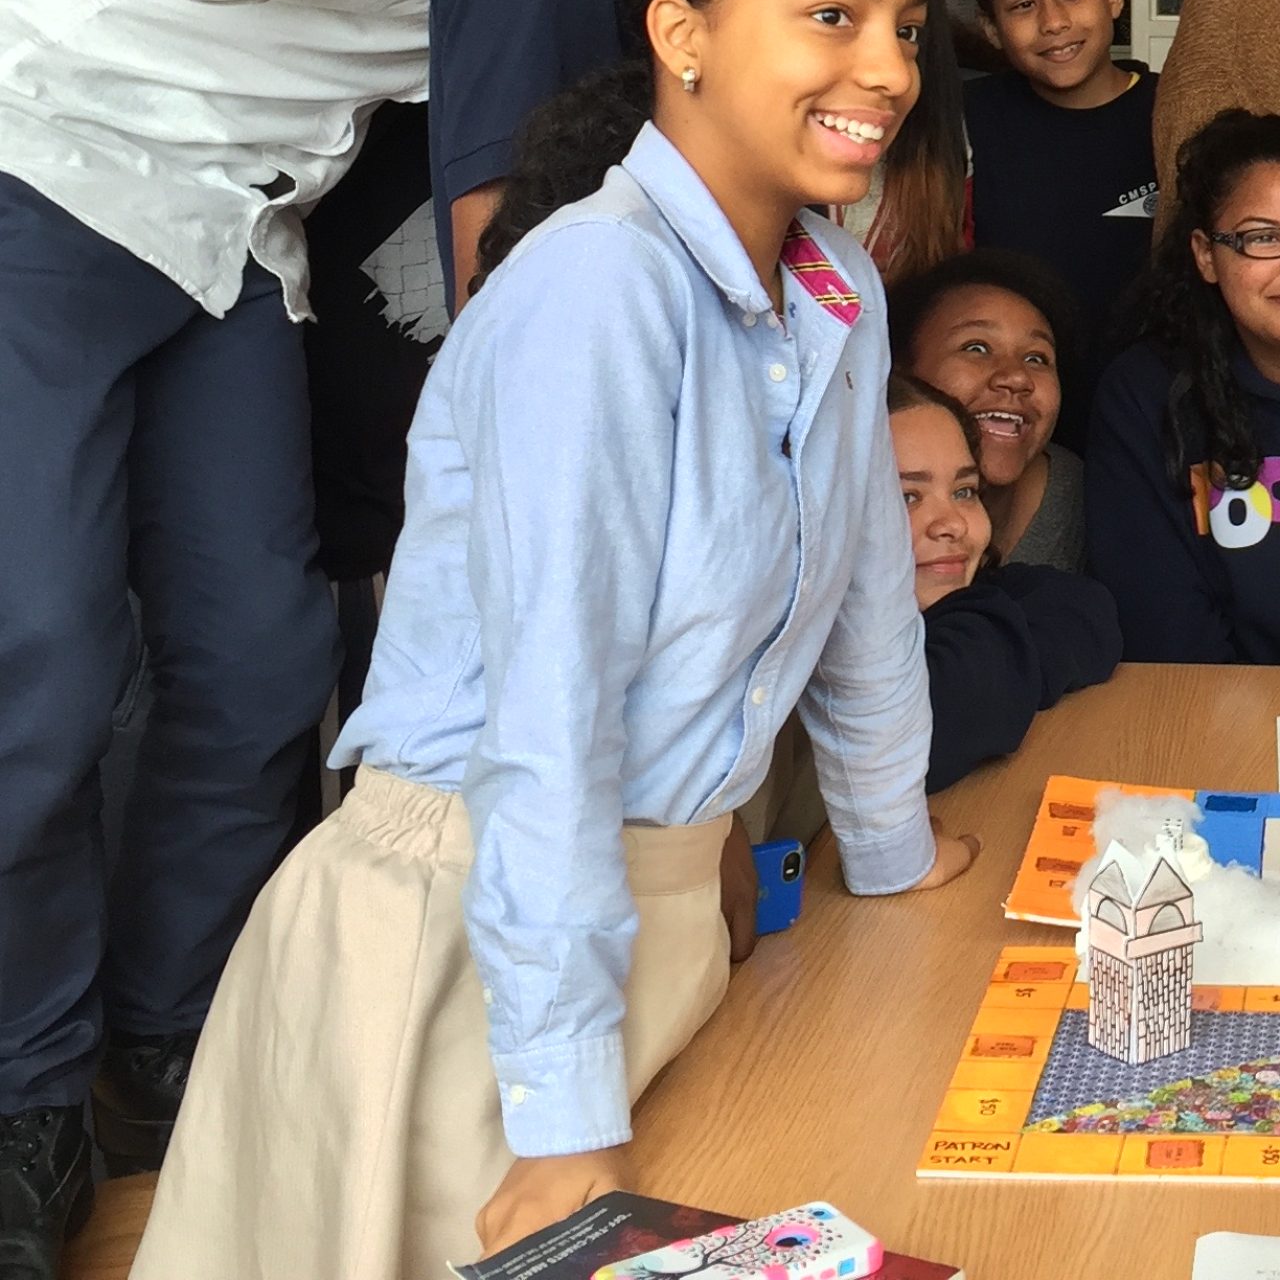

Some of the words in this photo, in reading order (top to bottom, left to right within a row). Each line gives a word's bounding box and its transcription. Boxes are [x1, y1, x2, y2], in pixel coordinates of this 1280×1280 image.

[1118, 181, 1157, 205] CMSP
[934, 1140, 1011, 1151] PATRON
[930, 1155, 998, 1165] START
